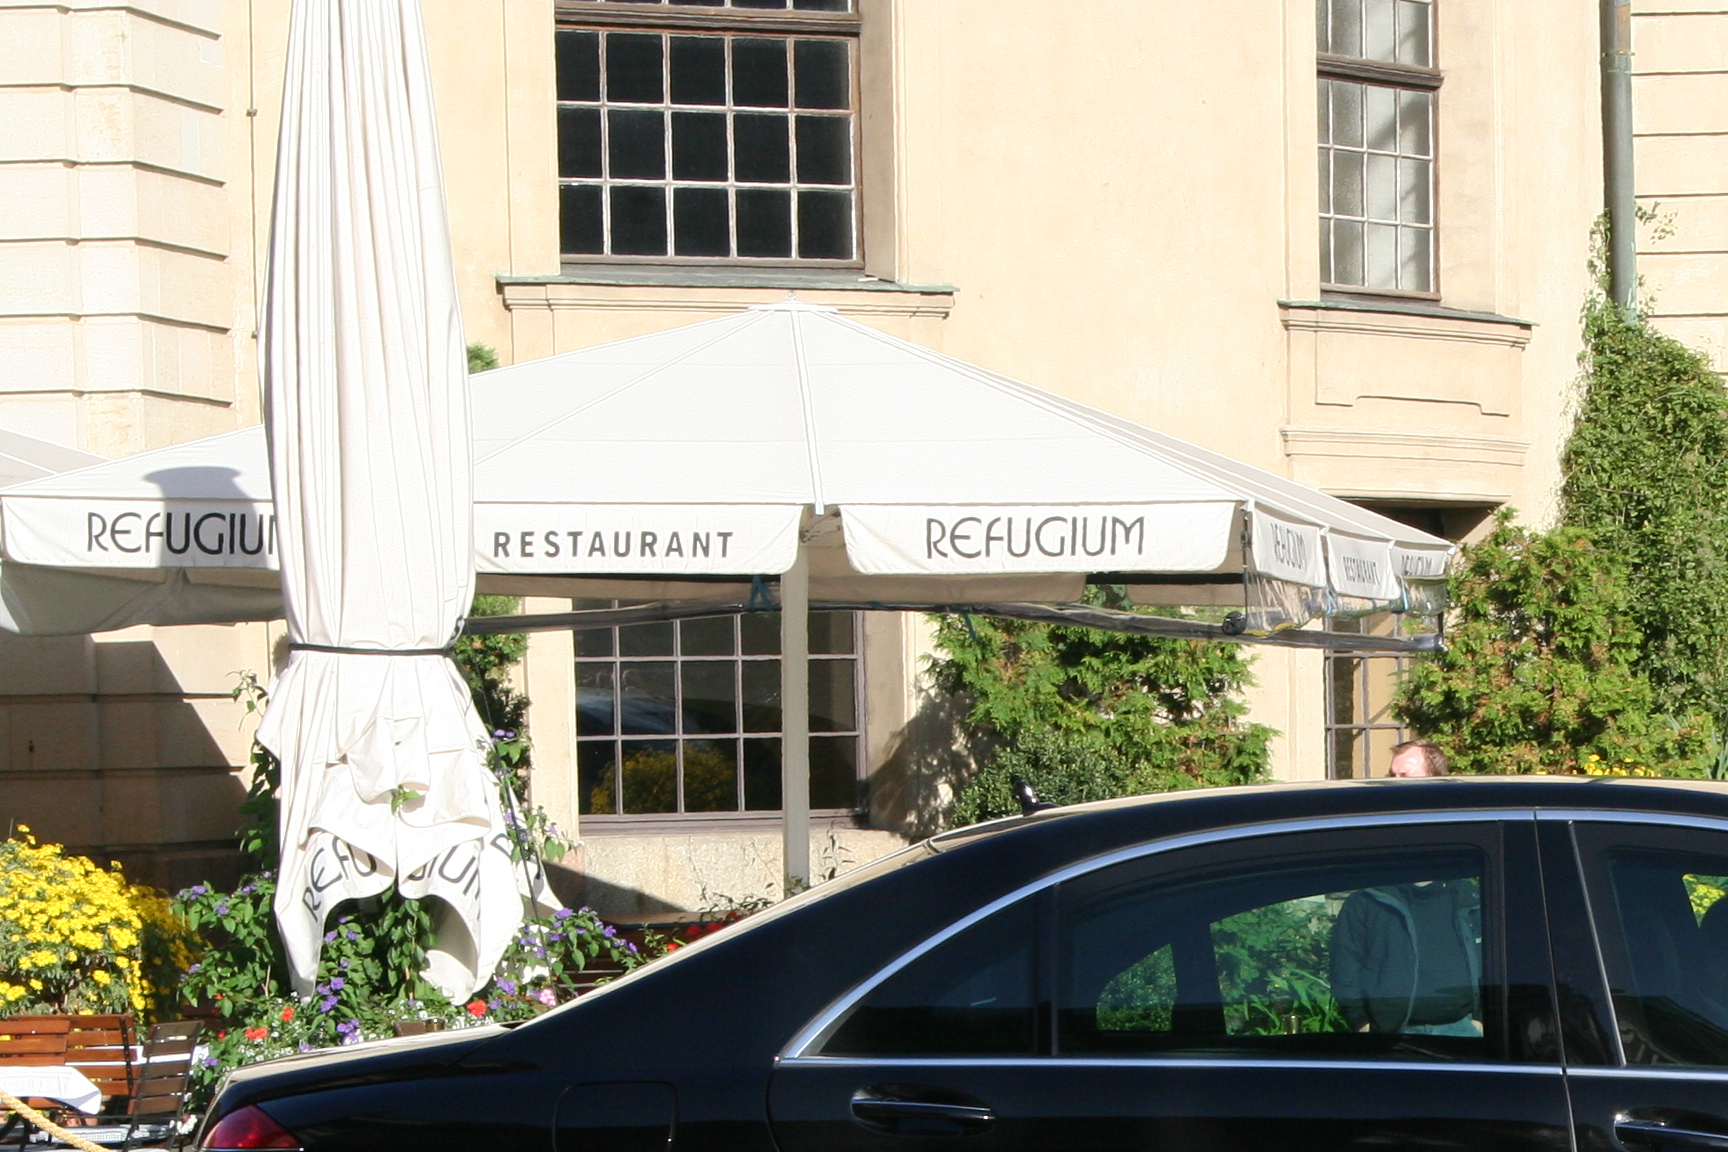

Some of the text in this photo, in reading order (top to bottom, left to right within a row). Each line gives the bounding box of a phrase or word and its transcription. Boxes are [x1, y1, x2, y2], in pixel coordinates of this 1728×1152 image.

[493, 530, 734, 559] RESTAURANT
[926, 515, 1145, 560] REFUGIUM
[302, 835, 481, 922] REFUIU
